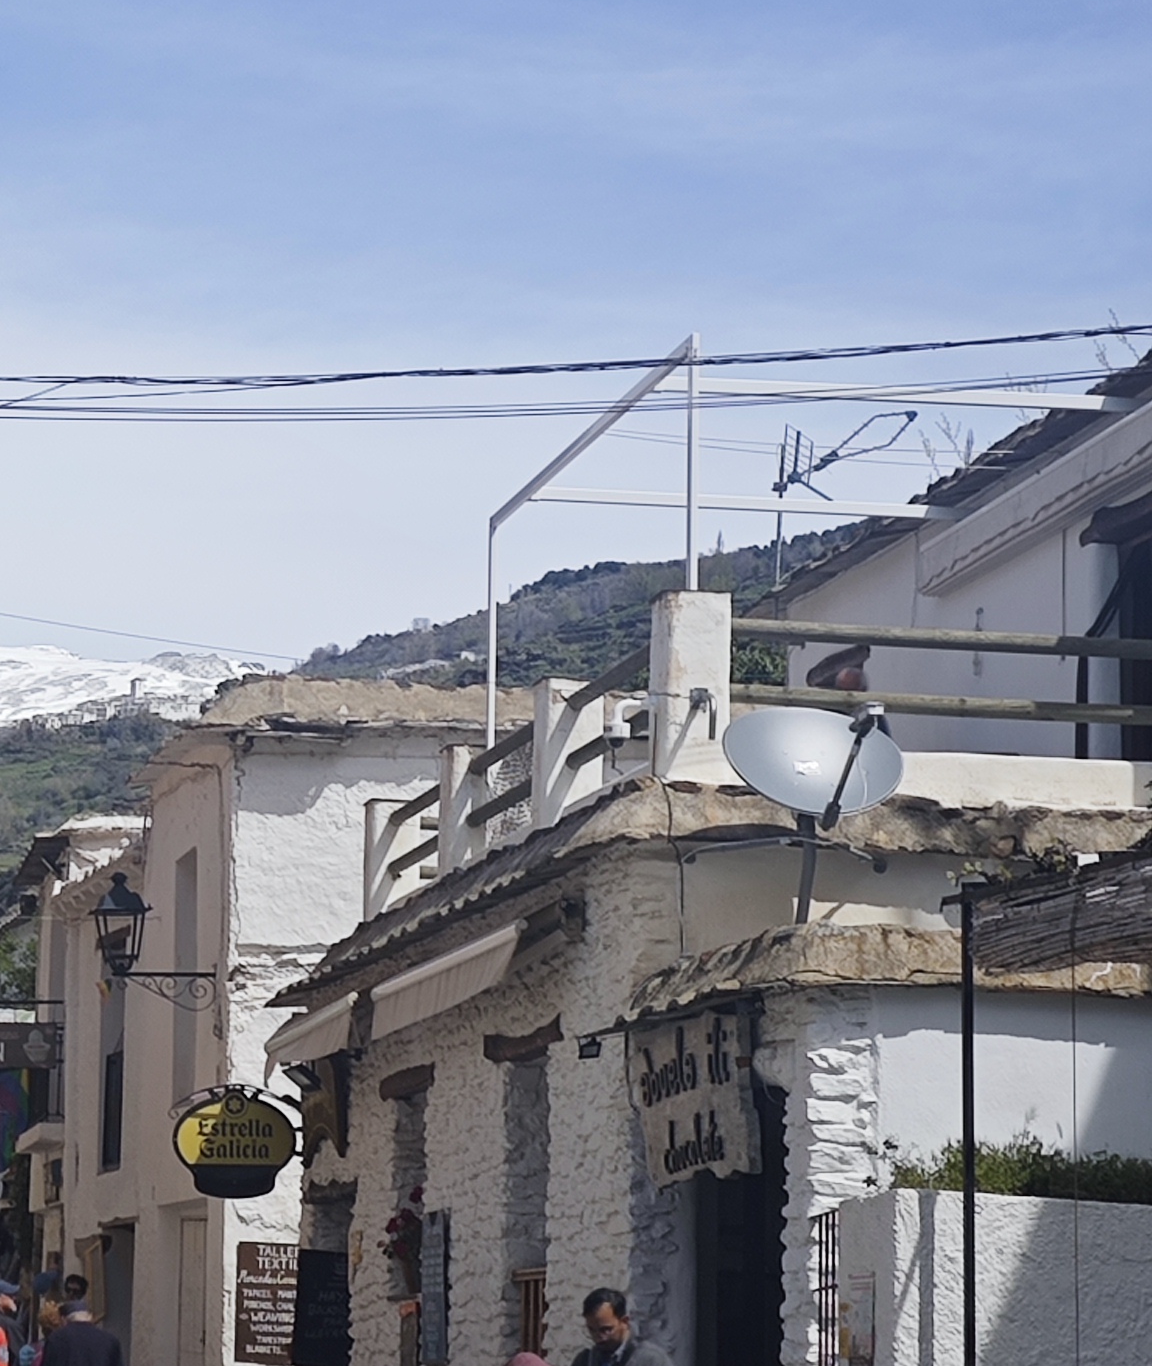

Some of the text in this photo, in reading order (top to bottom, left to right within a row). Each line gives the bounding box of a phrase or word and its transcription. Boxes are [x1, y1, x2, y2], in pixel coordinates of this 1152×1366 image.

[640, 1026, 697, 1107] abuela
[197, 1118, 273, 1138] Estrella
[200, 1138, 270, 1159] Galicia
[664, 1110, 725, 1175] chocolate
